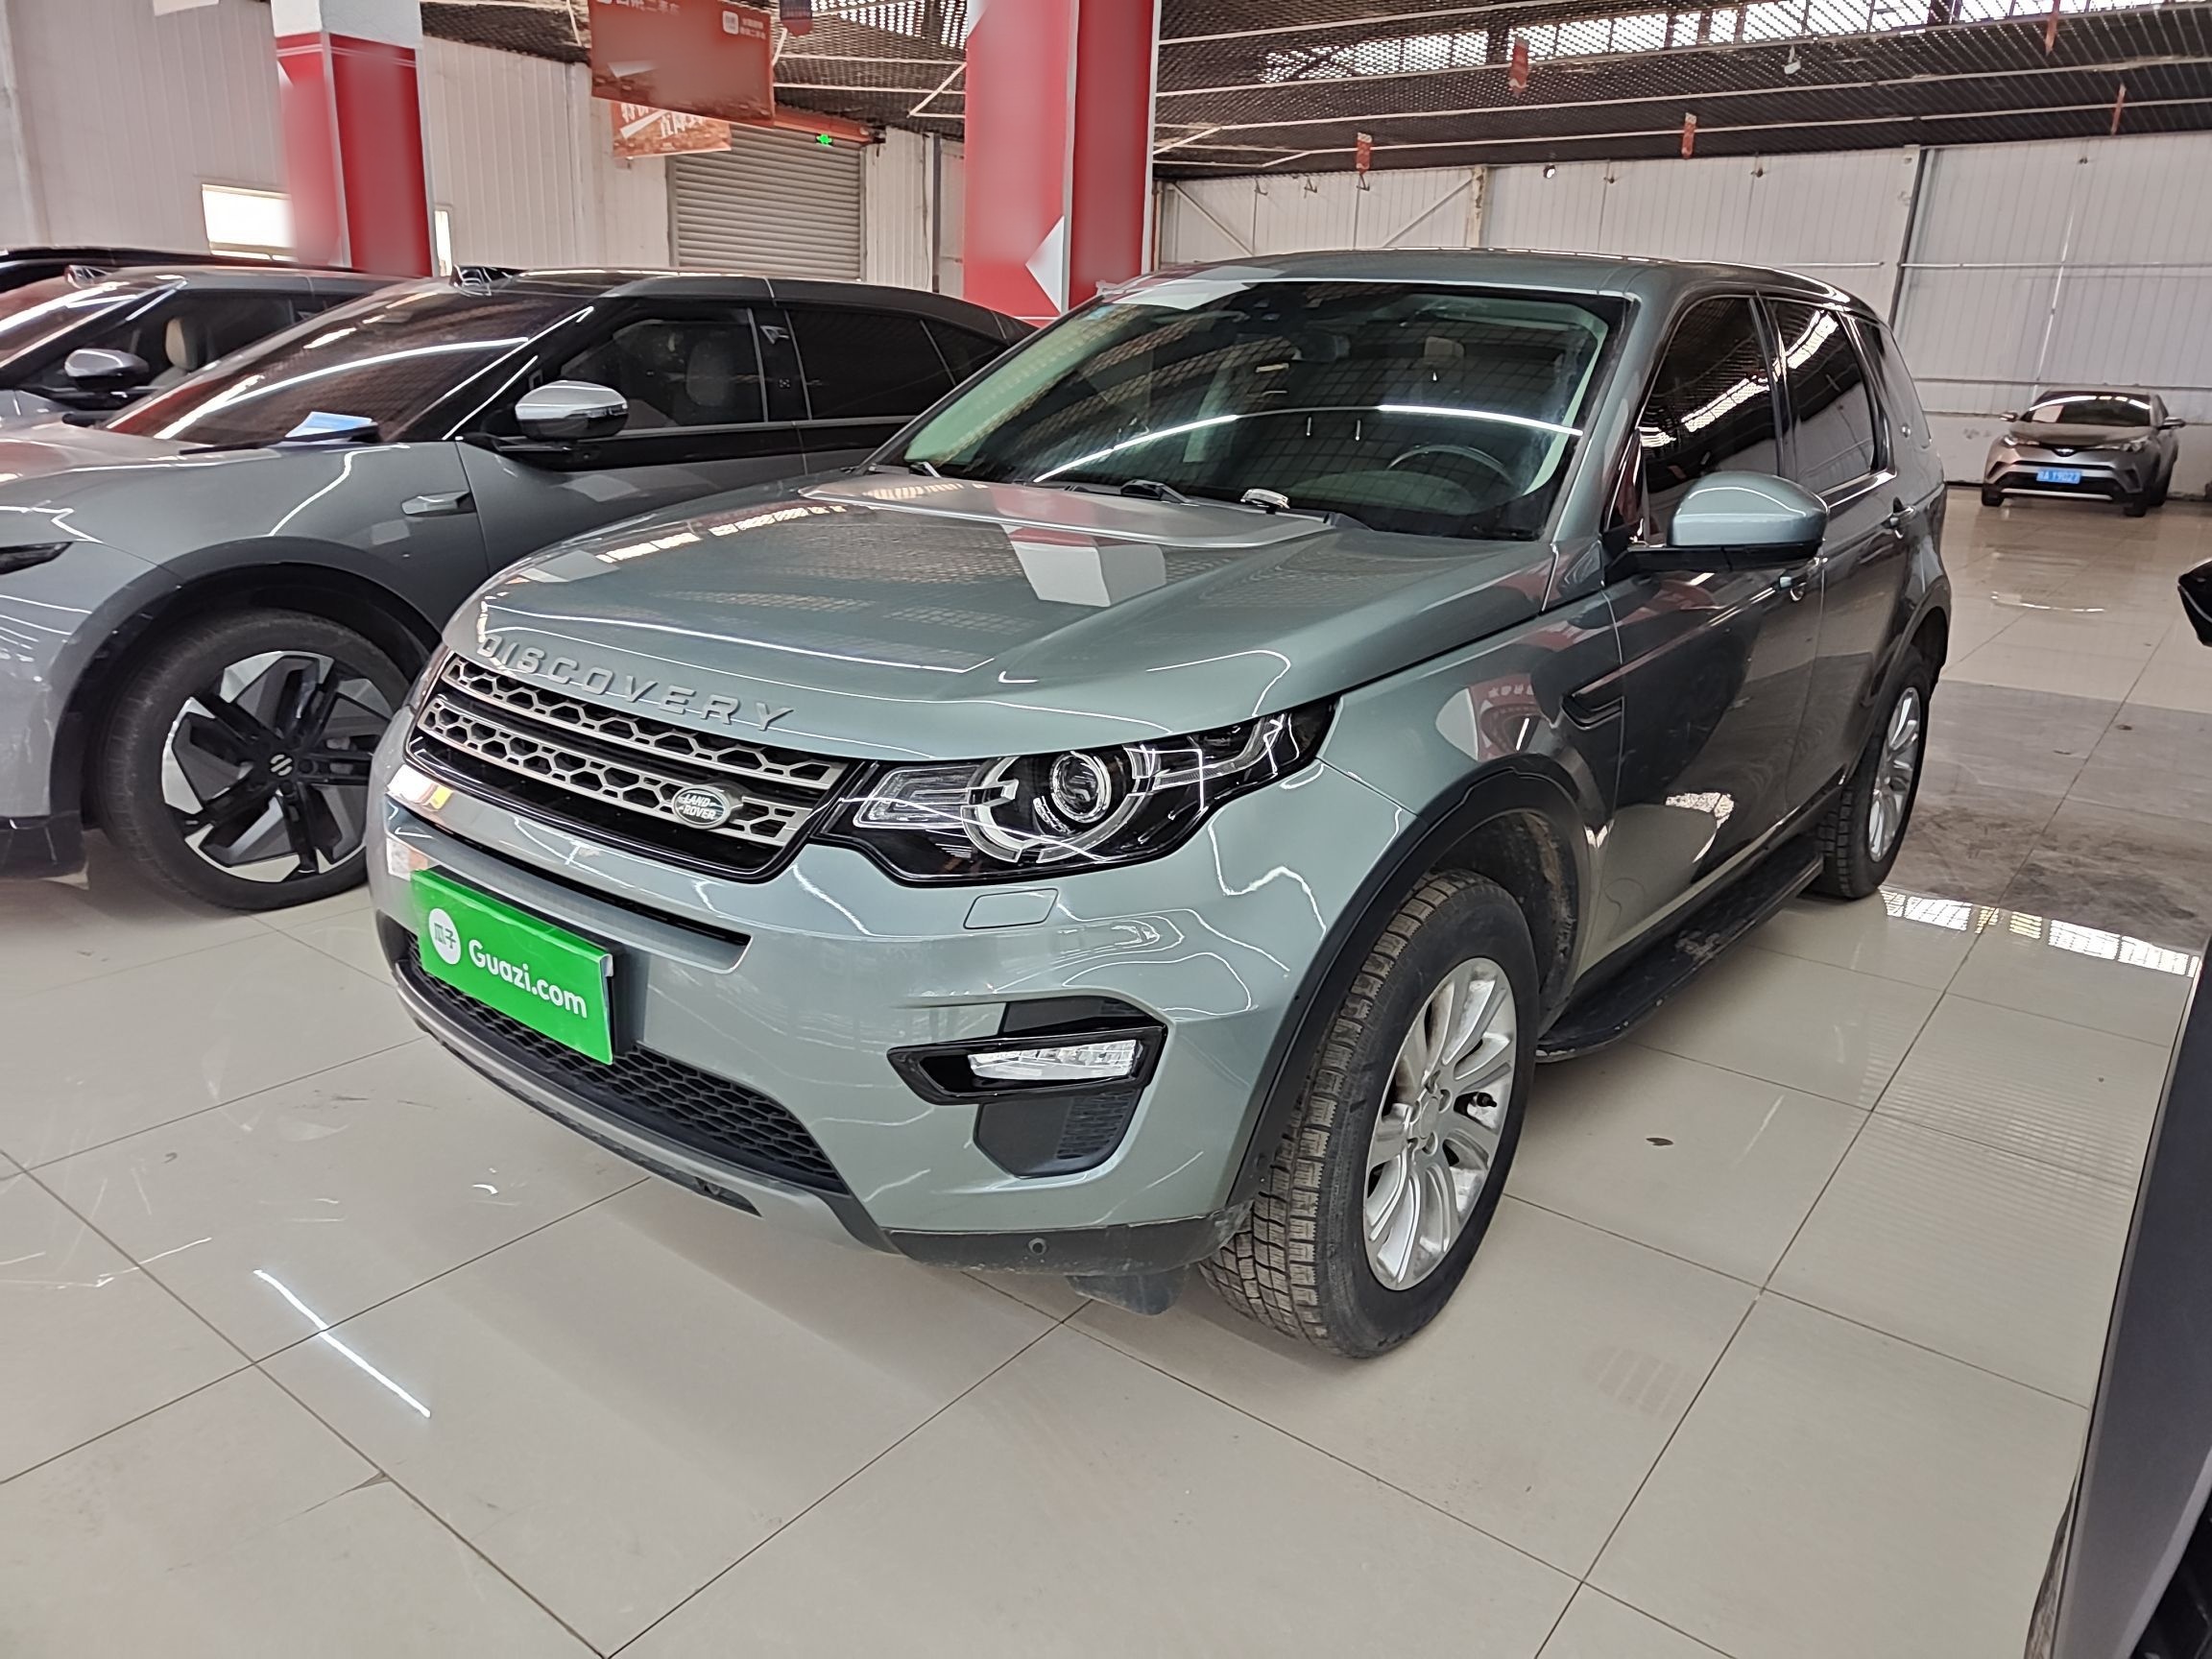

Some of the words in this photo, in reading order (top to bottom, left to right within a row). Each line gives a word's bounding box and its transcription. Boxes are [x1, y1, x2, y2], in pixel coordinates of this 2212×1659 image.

[476, 635, 794, 732] DISCOVERY
[683, 804, 717, 821] ROVER
[685, 793, 711, 807] LAND
[434, 923, 456, 949] 瓜子
[469, 939, 588, 1019] Guazi.com
